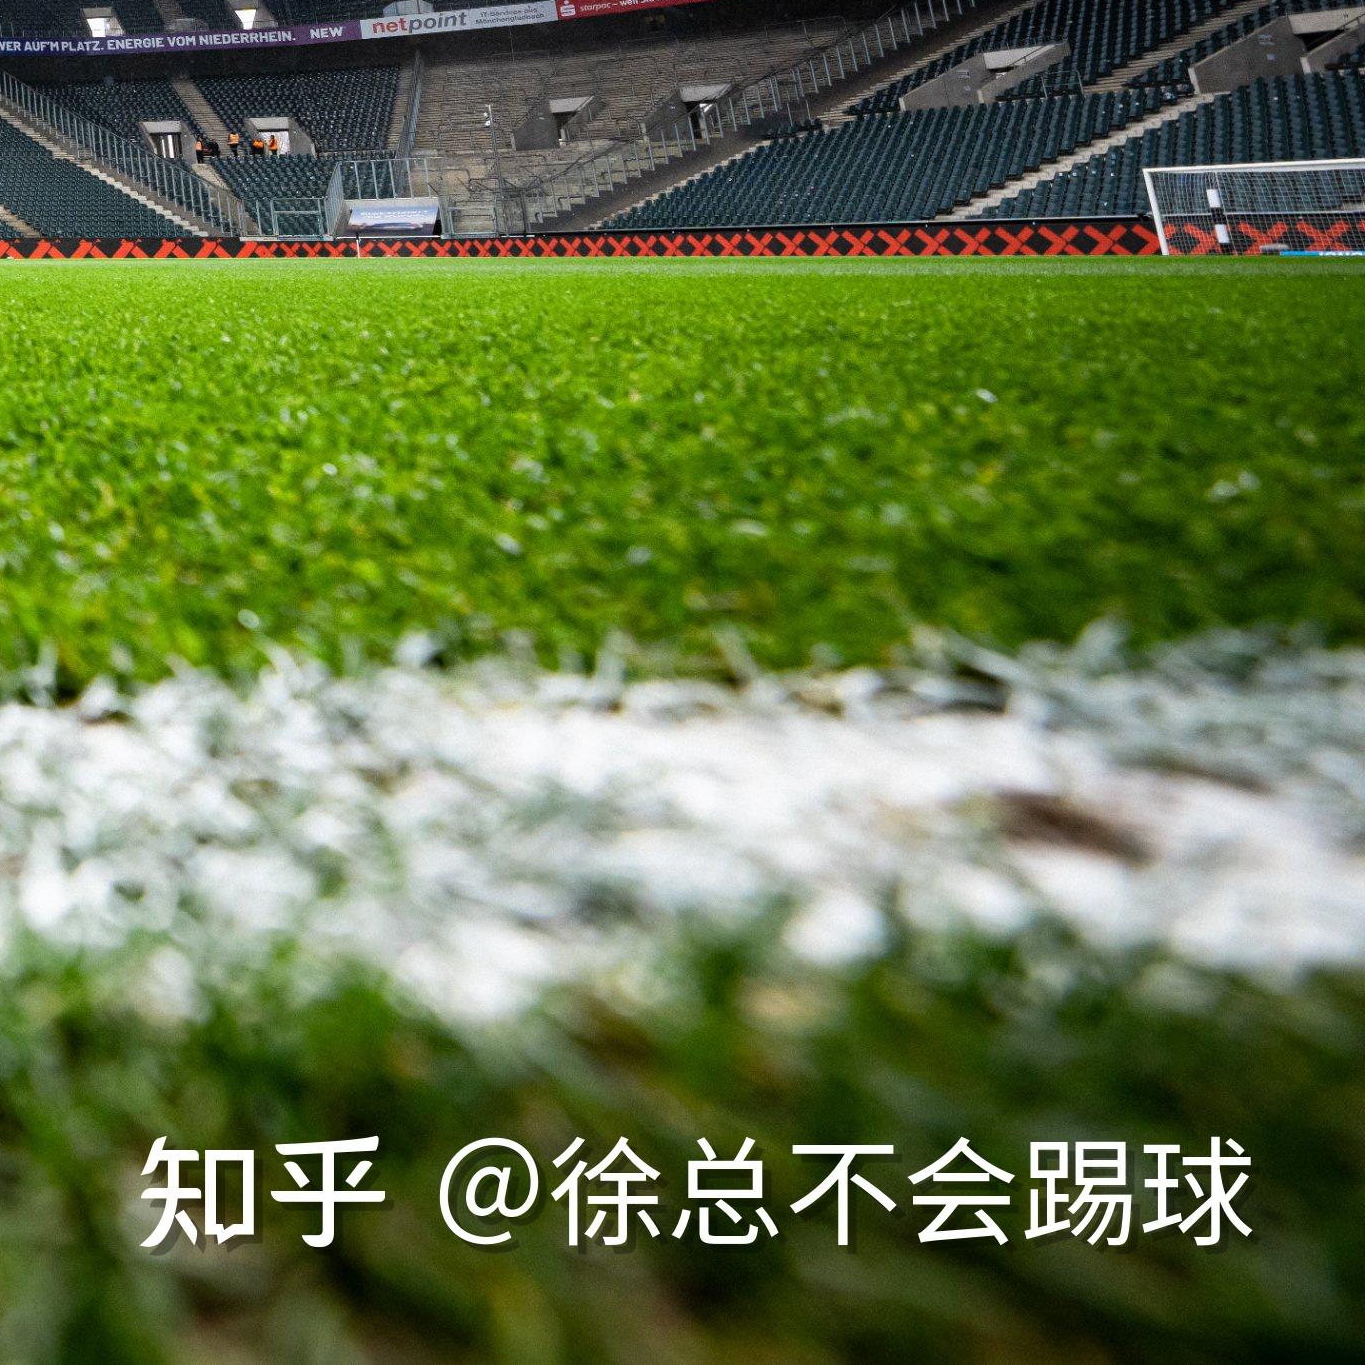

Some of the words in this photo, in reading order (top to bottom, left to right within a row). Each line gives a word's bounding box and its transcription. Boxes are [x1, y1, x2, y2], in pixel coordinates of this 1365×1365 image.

[372, 12, 467, 34] netpoint
[61, 41, 104, 52] PLATZ.
[107, 37, 165, 50] ENERGIE
[167, 36, 196, 47] VOM
[199, 30, 296, 45] NIEDERRHEIN.
[309, 26, 343, 39] NEW
